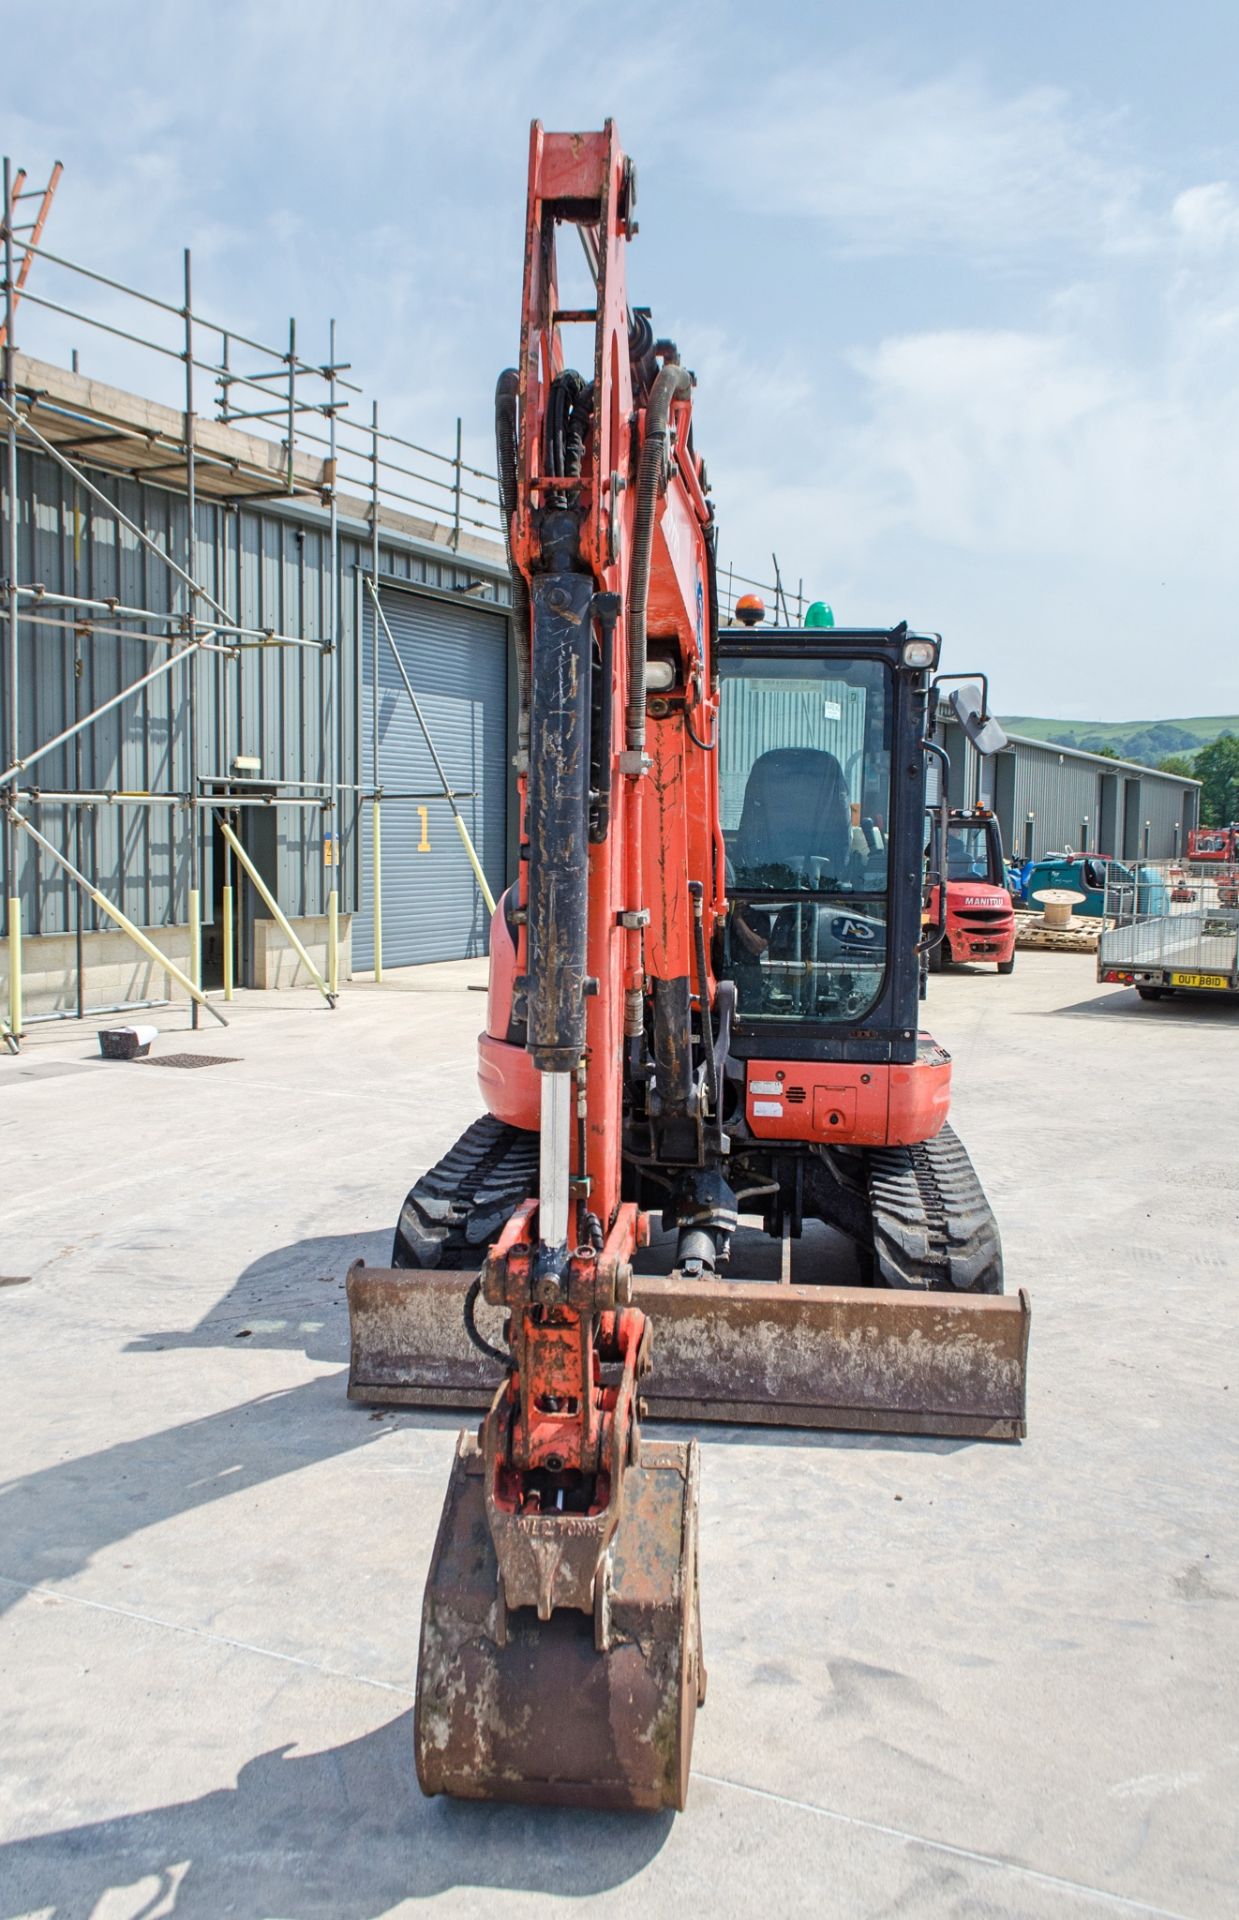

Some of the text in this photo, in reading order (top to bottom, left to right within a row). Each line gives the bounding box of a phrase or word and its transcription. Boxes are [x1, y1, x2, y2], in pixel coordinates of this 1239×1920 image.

[417, 805, 432, 852] 1
[964, 896, 1004, 906] MANITOU
[1178, 974, 1197, 985] OUT
